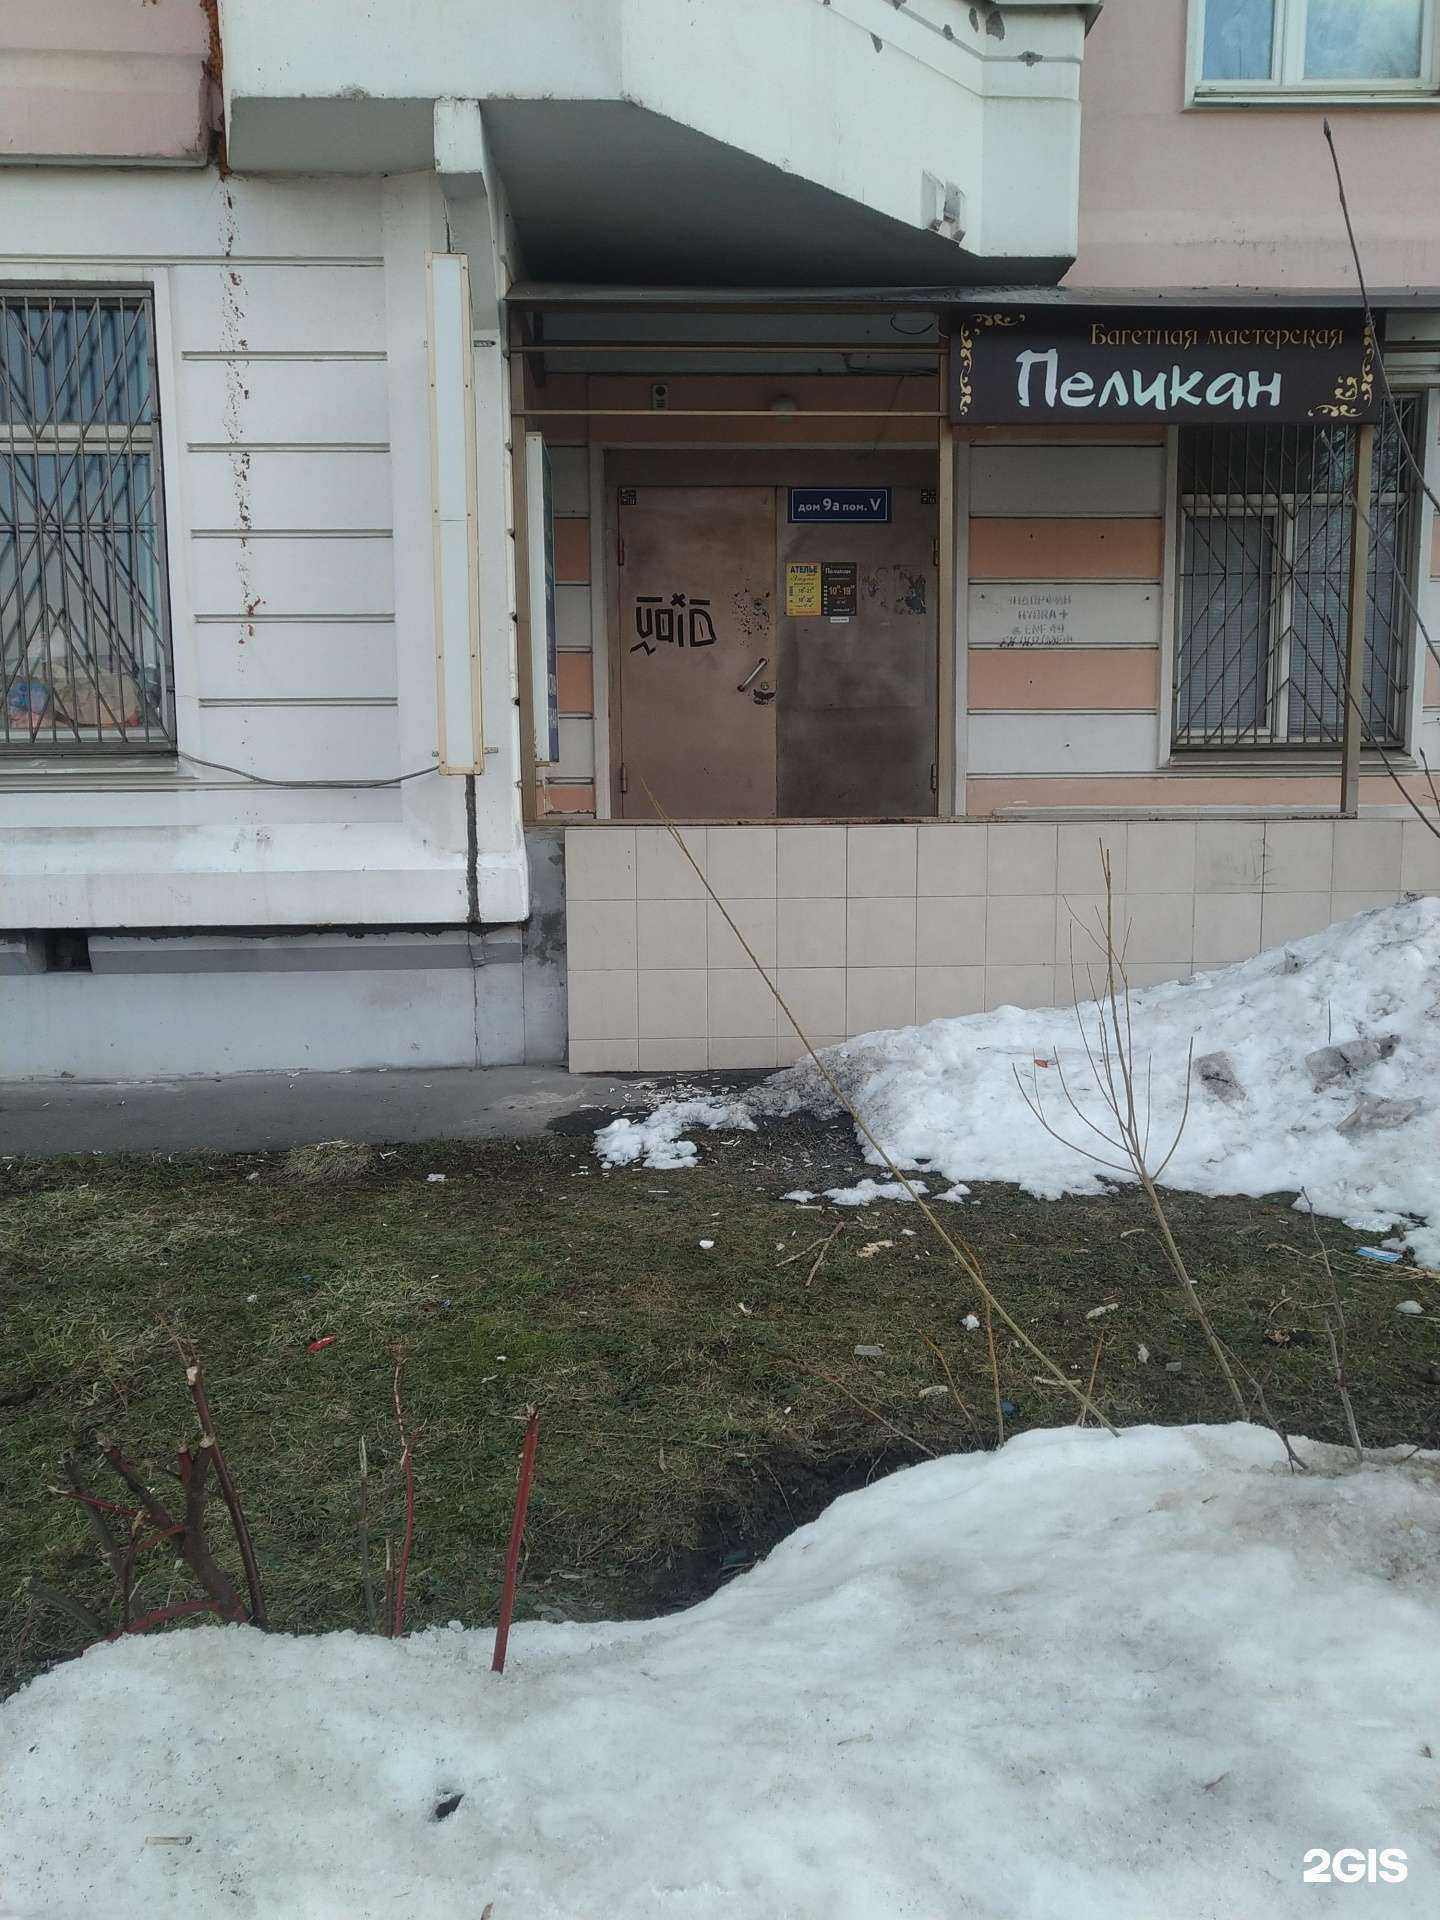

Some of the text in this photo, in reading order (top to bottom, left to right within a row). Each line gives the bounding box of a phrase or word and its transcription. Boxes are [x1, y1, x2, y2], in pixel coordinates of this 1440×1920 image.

[1090, 323, 1344, 350] Багетная мастерская
[1015, 348, 1282, 410] Пеликан
[798, 504, 820, 512] дом
[870, 498, 881, 511] V
[791, 565, 817, 573] АТЕЛЬЕ
